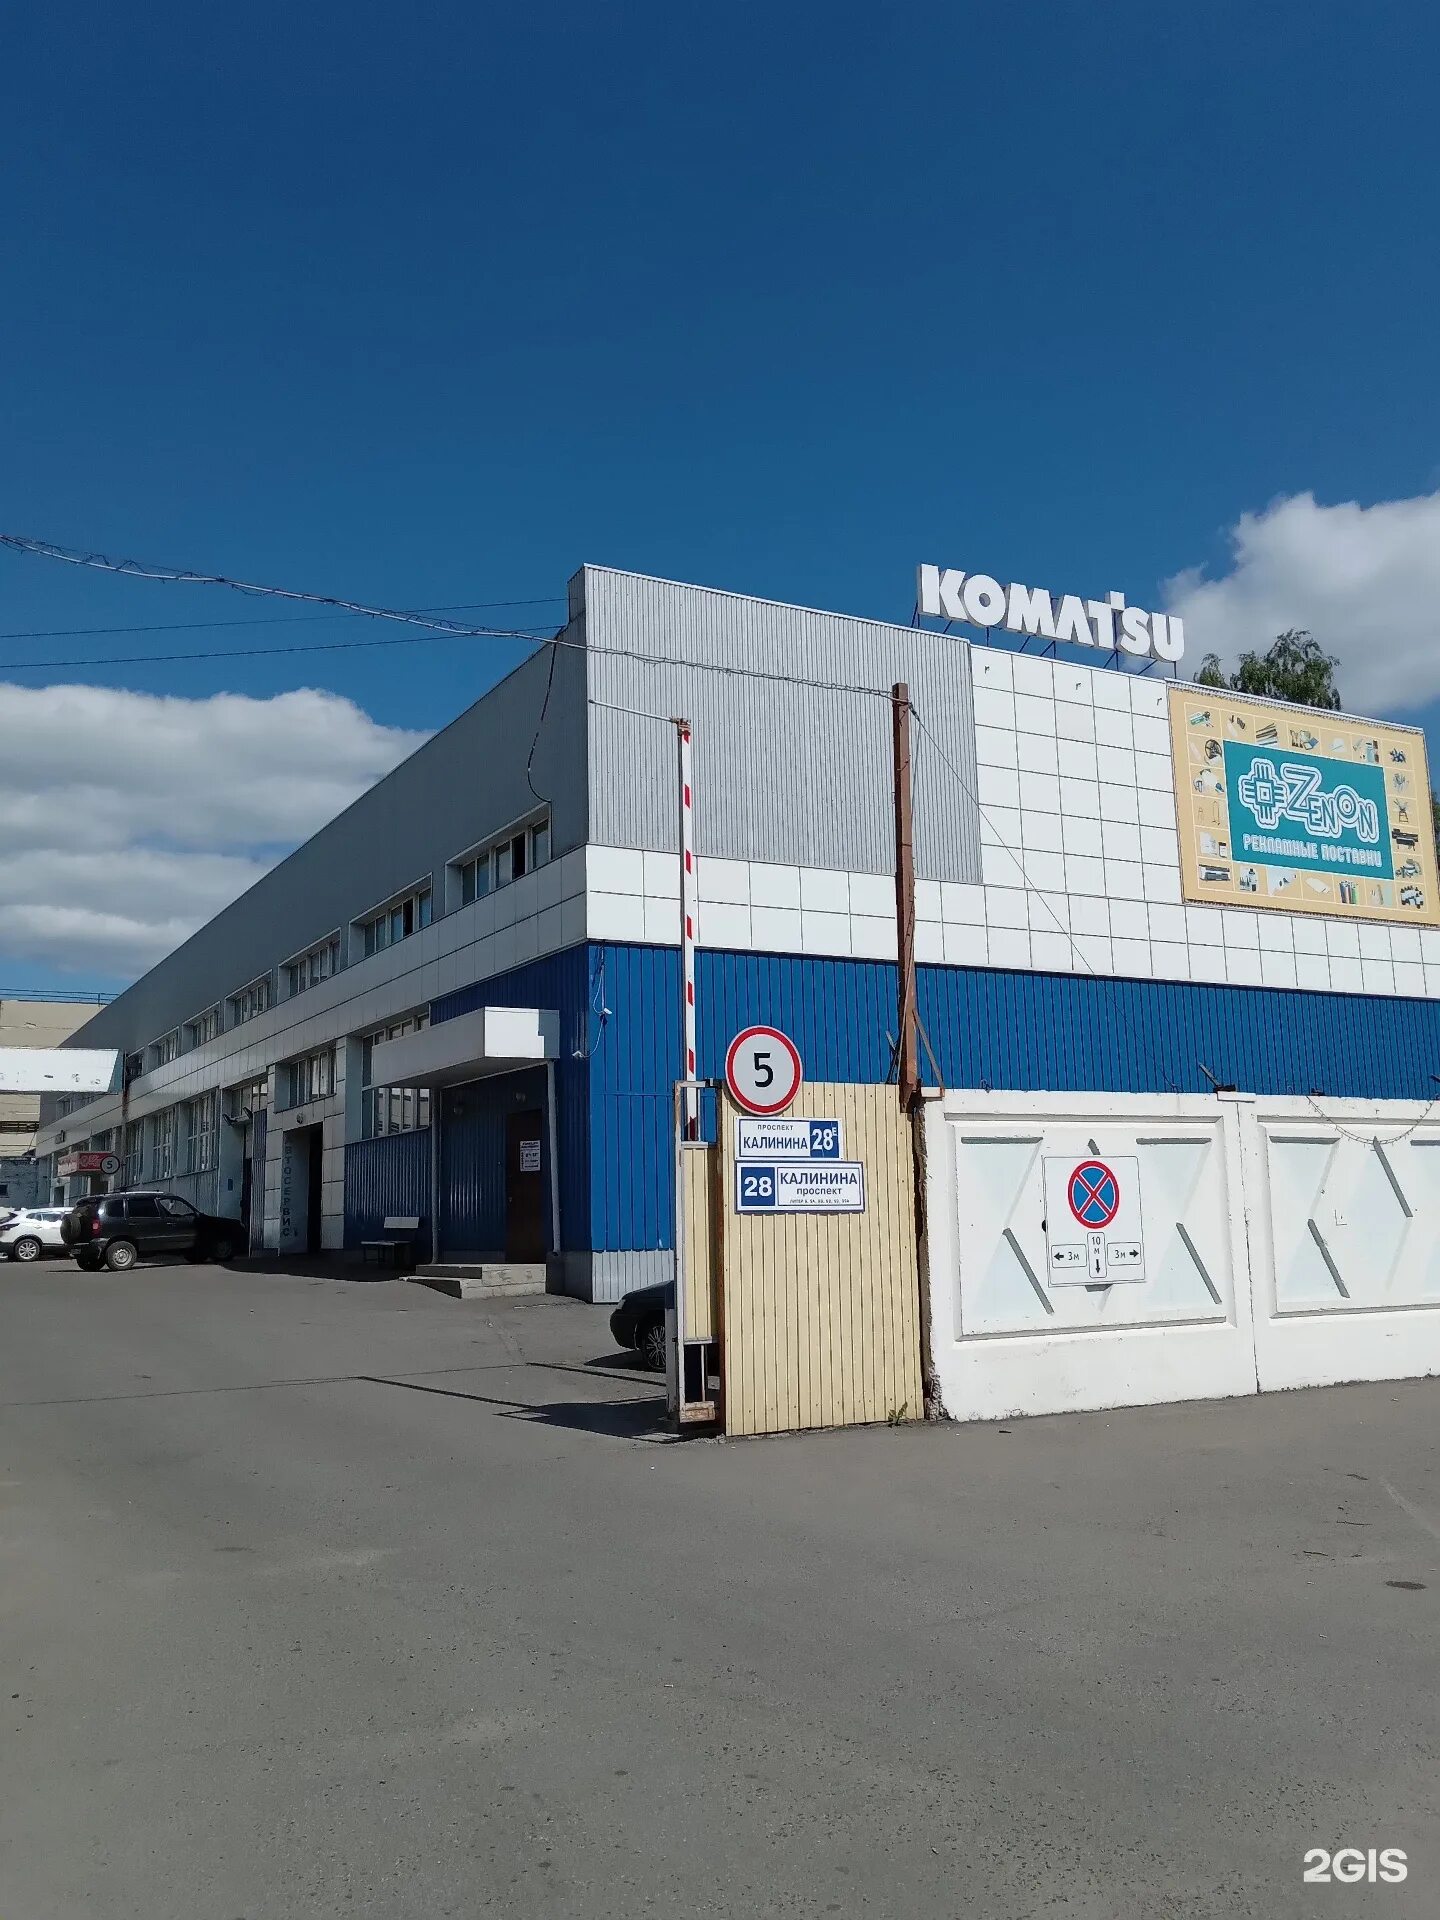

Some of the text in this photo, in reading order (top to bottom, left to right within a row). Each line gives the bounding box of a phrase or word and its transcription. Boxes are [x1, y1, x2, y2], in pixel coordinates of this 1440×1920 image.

[918, 563, 1185, 662] KOMATSU
[1243, 833, 1383, 867] РЕКЛАМНЫЕ ПОСТАВКИ
[753, 1052, 774, 1088] 5
[743, 1136, 808, 1150] КАЛИНИНА
[106, 1161, 113, 1169] 5
[282, 1135, 293, 1237] ВТОСЕРВИС
[744, 1176, 773, 1197] 28
[780, 1172, 858, 1185] КАЛИНИНА
[796, 1187, 843, 1196] проспект
[1091, 1236, 1101, 1245] 10
